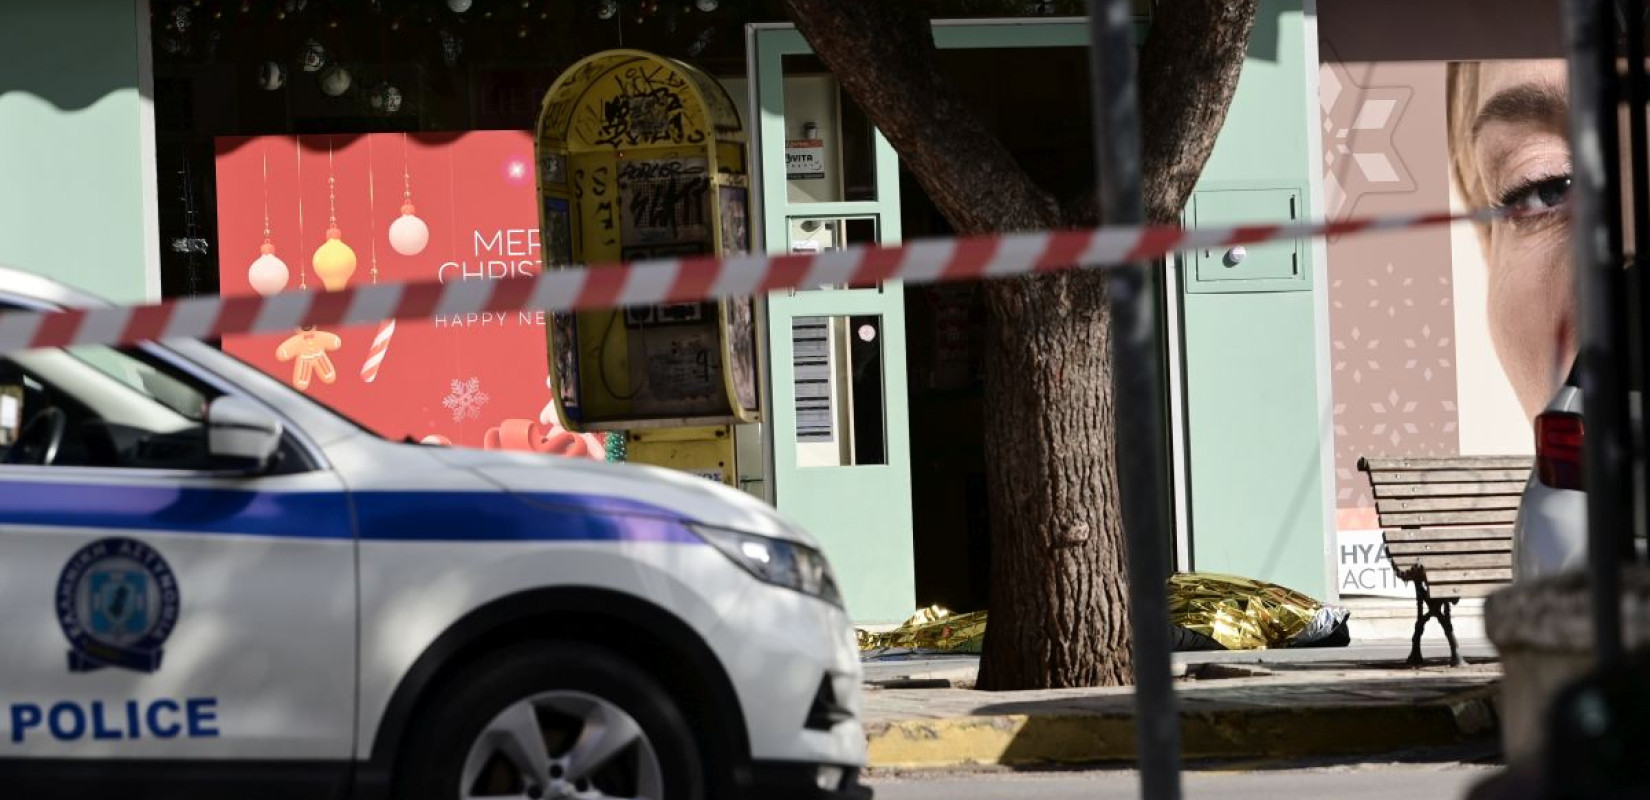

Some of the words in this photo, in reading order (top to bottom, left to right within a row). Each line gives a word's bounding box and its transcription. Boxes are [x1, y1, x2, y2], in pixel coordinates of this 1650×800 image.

[435, 311, 507, 328] HAPPY
[519, 311, 547, 326] NE
[1341, 543, 1388, 565] HYA
[1342, 567, 1409, 590] ACTI
[10, 697, 220, 744] POLICE
